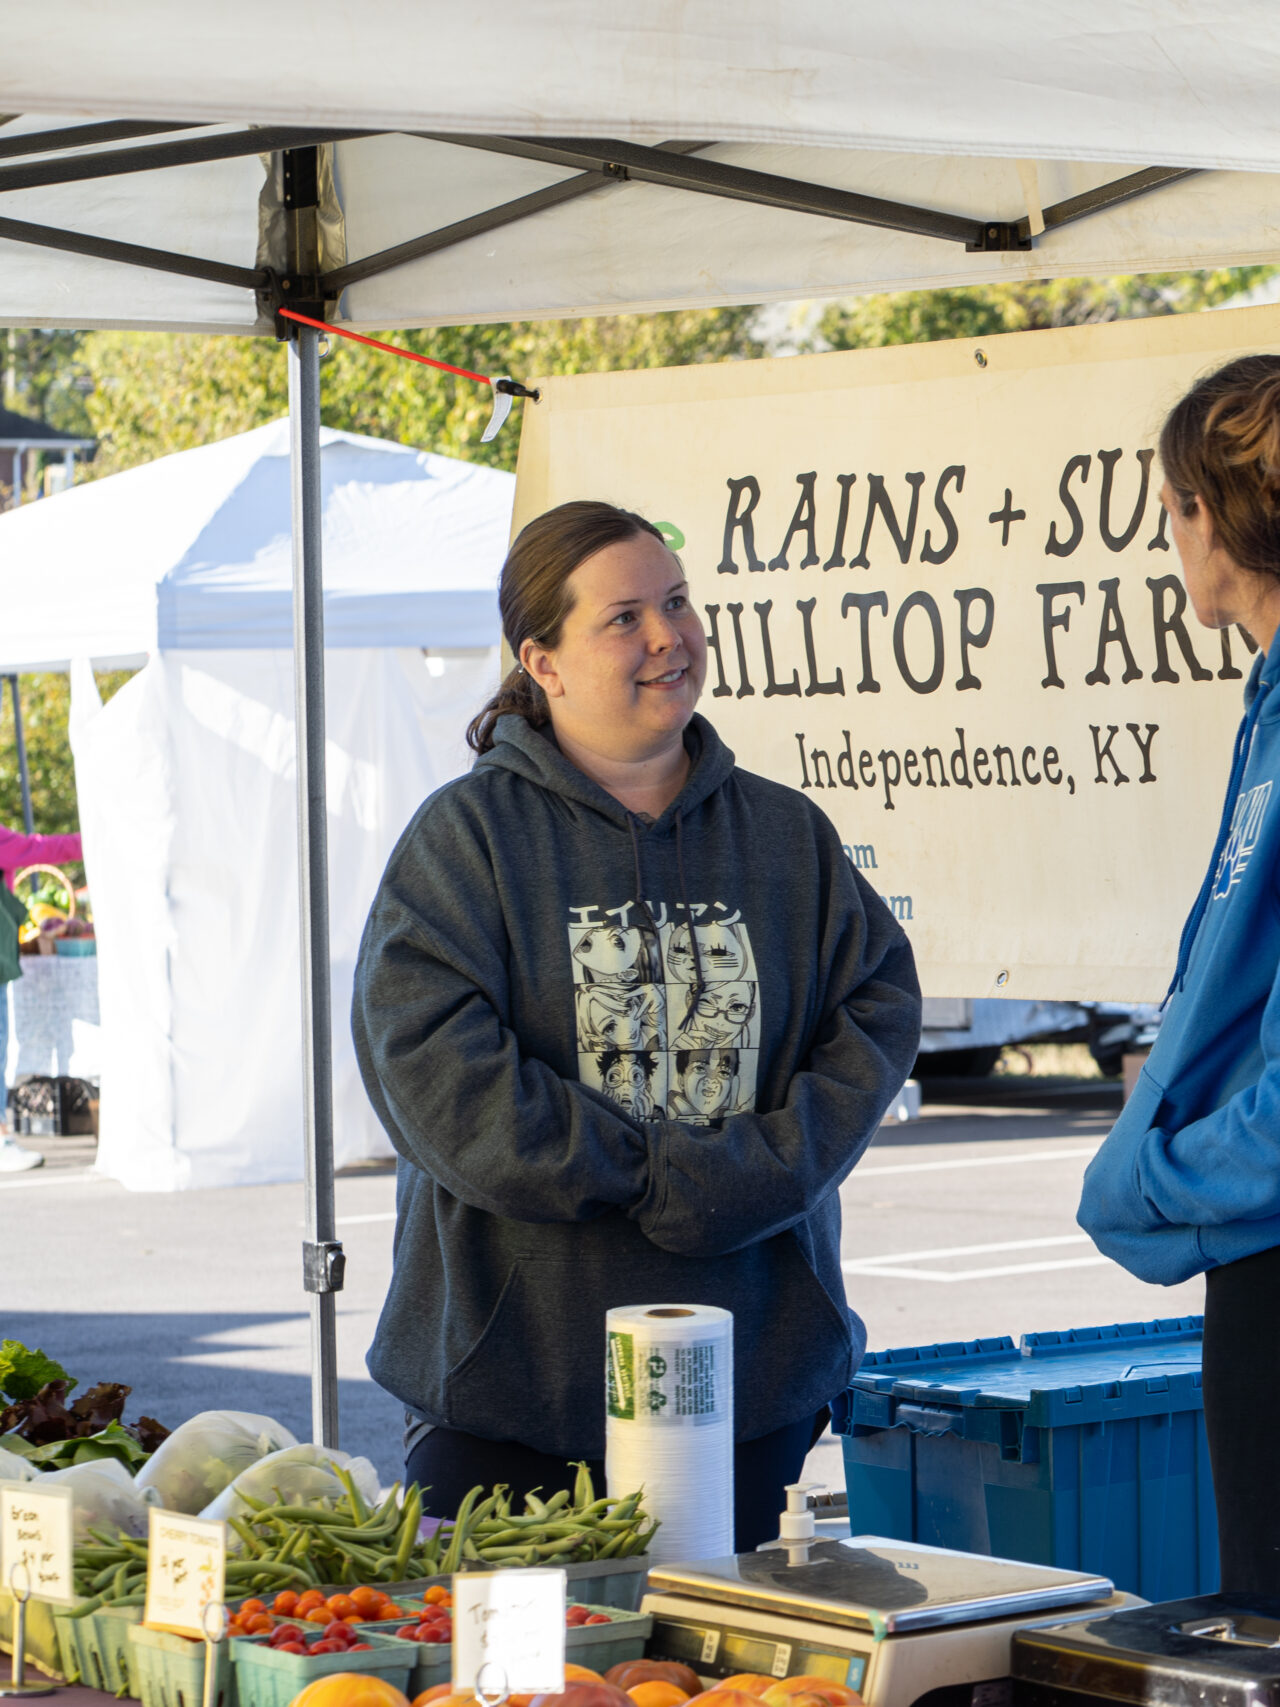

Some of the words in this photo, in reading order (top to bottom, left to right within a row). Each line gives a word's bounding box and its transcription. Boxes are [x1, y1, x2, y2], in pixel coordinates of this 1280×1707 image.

[716, 464, 966, 575] RAINS
[1044, 447, 1171, 558] SU
[795, 727, 1076, 811] Independence,
[1088, 722, 1160, 787] KY
